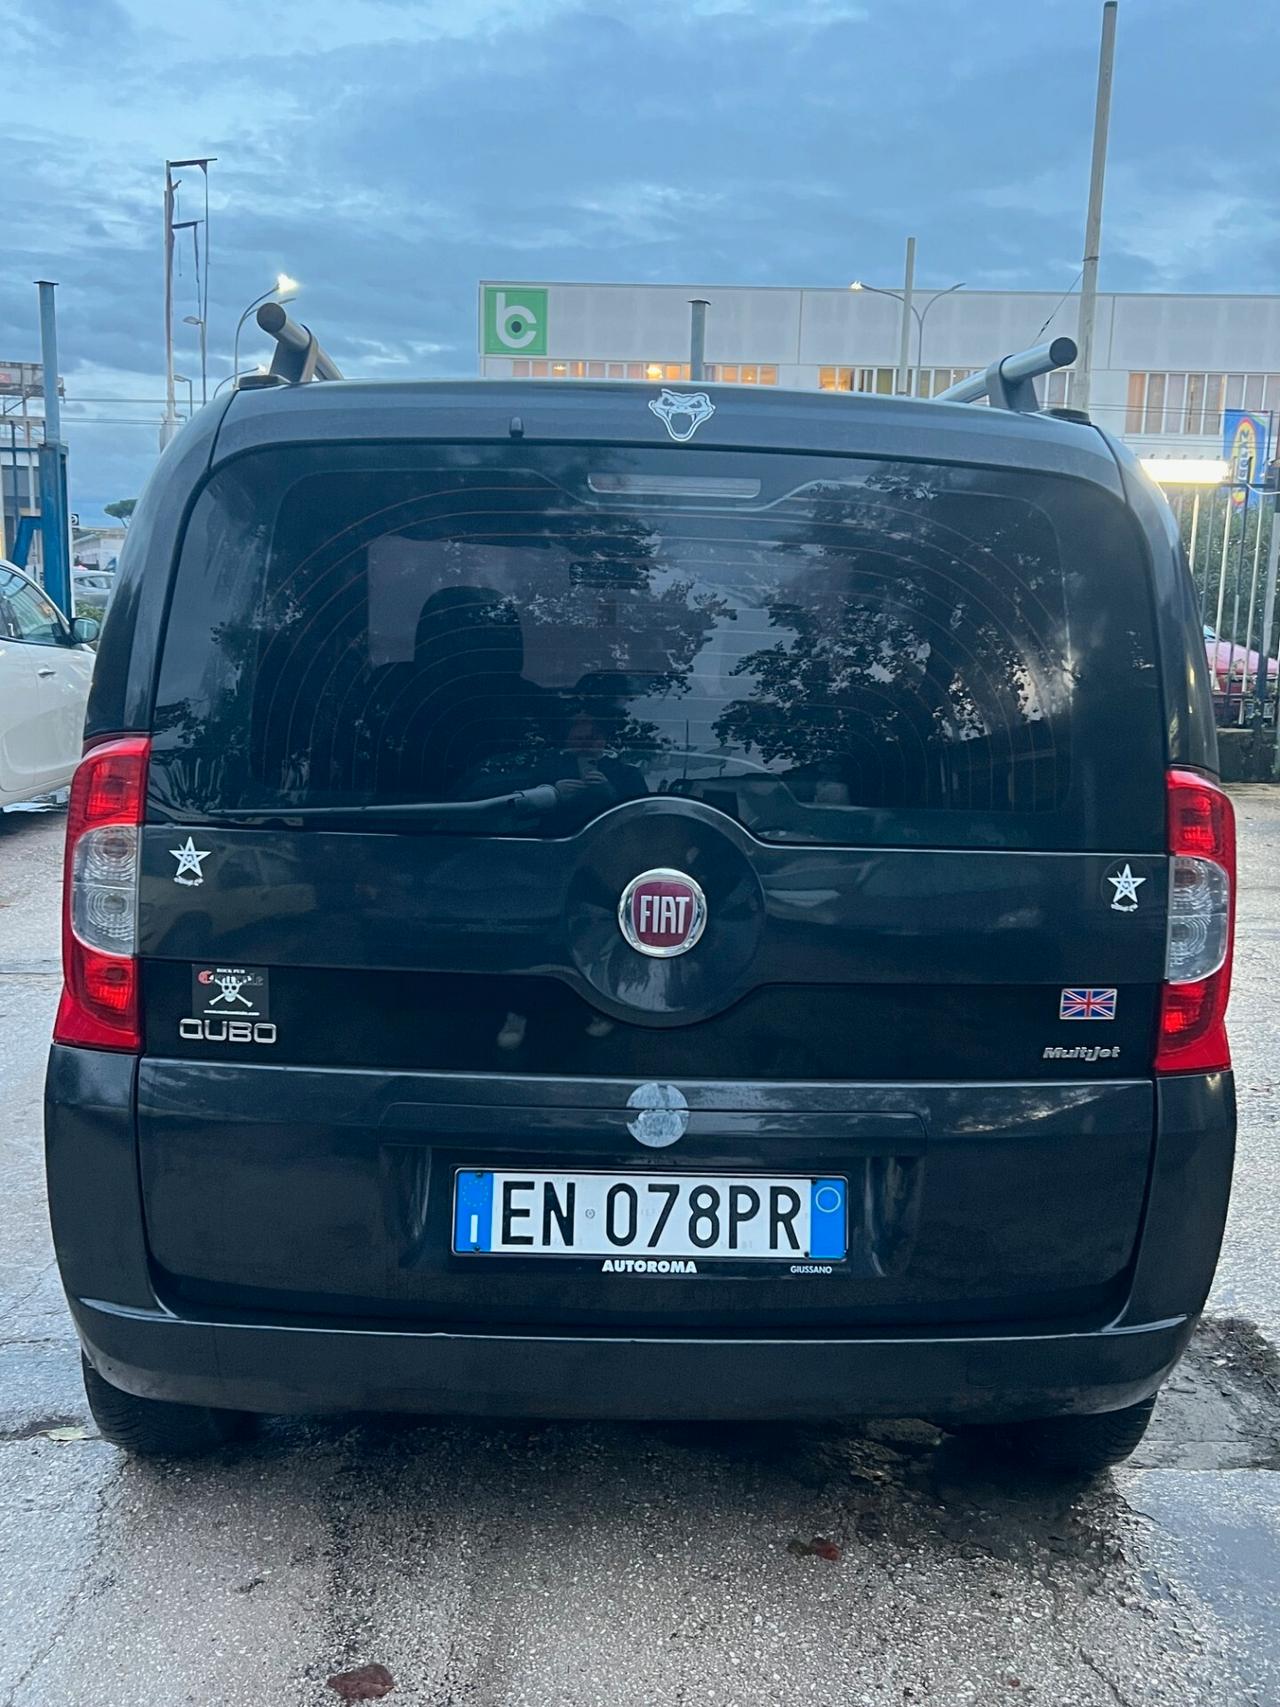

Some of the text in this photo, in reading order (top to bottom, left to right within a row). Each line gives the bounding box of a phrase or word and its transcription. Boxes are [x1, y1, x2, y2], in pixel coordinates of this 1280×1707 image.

[640, 895, 690, 934] FIAT
[180, 1018, 277, 1044] QUBO
[501, 1181, 576, 1246] EN
[605, 1182, 801, 1250] 078PR
[601, 1259, 698, 1274] AUTOROMA
[790, 1265, 833, 1274] GIUSSANO
